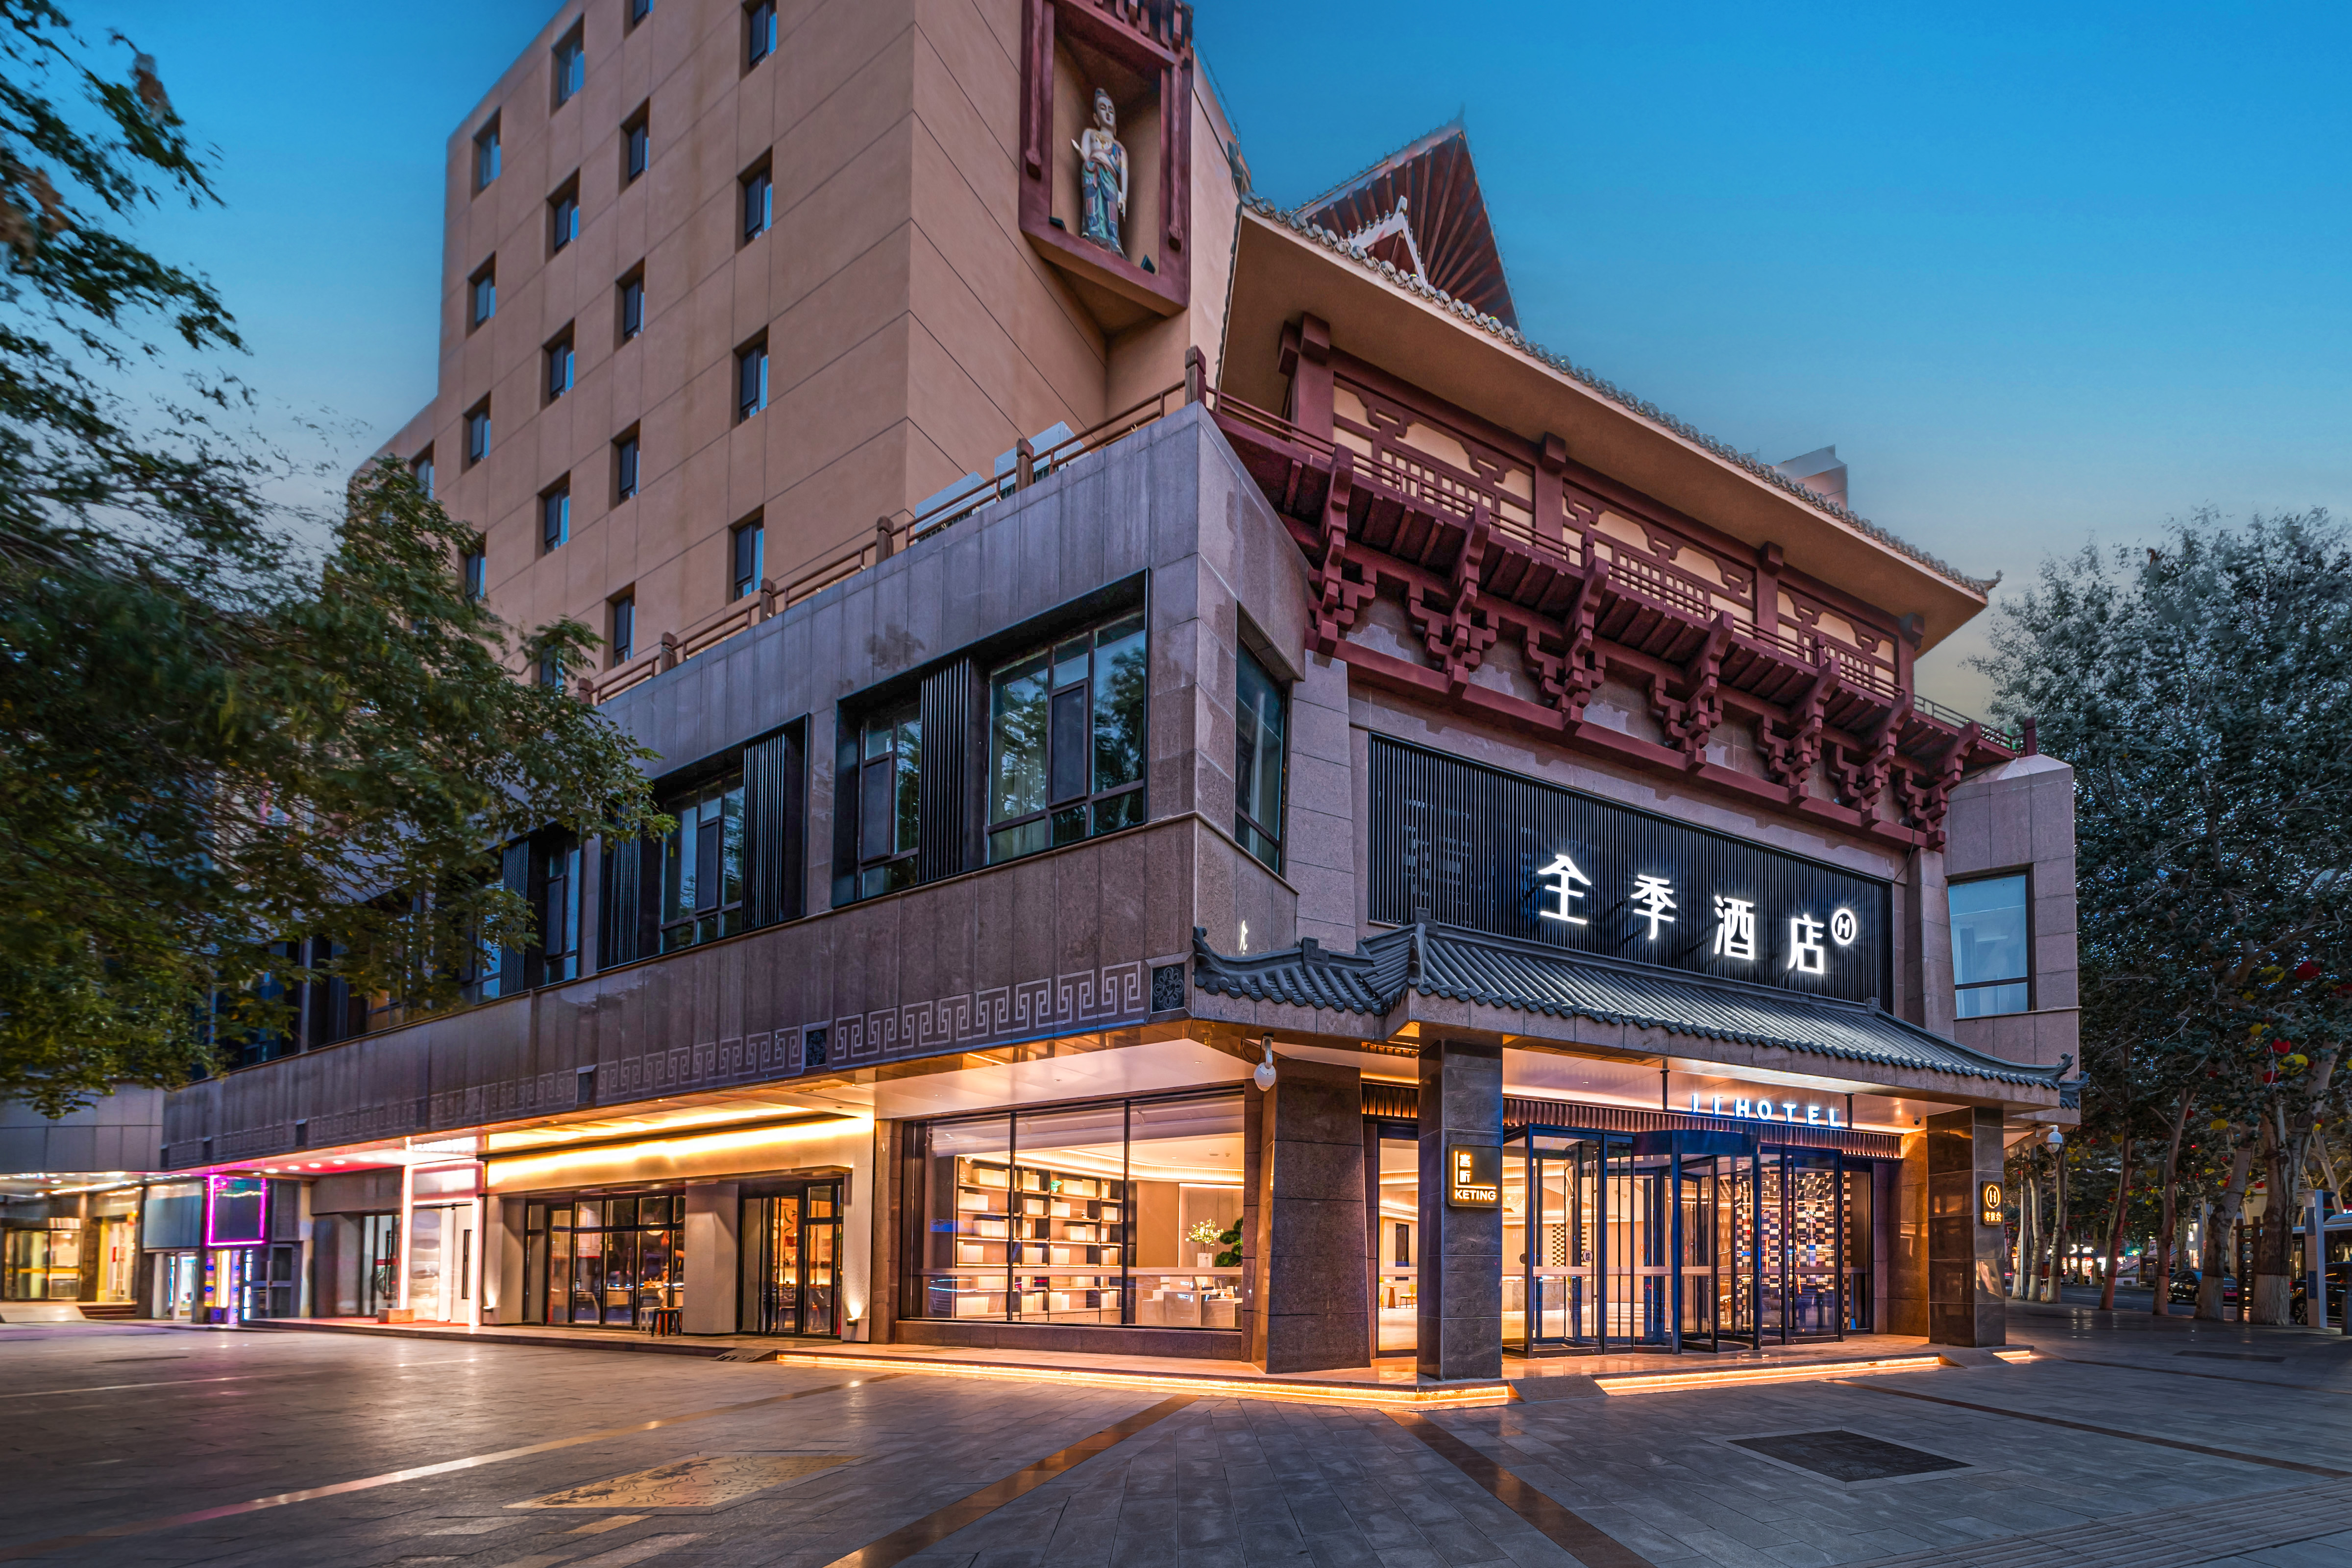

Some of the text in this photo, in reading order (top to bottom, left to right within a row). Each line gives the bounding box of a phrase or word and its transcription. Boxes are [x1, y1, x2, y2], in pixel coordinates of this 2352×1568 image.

[1538, 855, 1824, 974] 全季酒店
[1735, 1098, 1840, 1127] HOTEL
[1455, 1189, 1496, 1200] KETING
